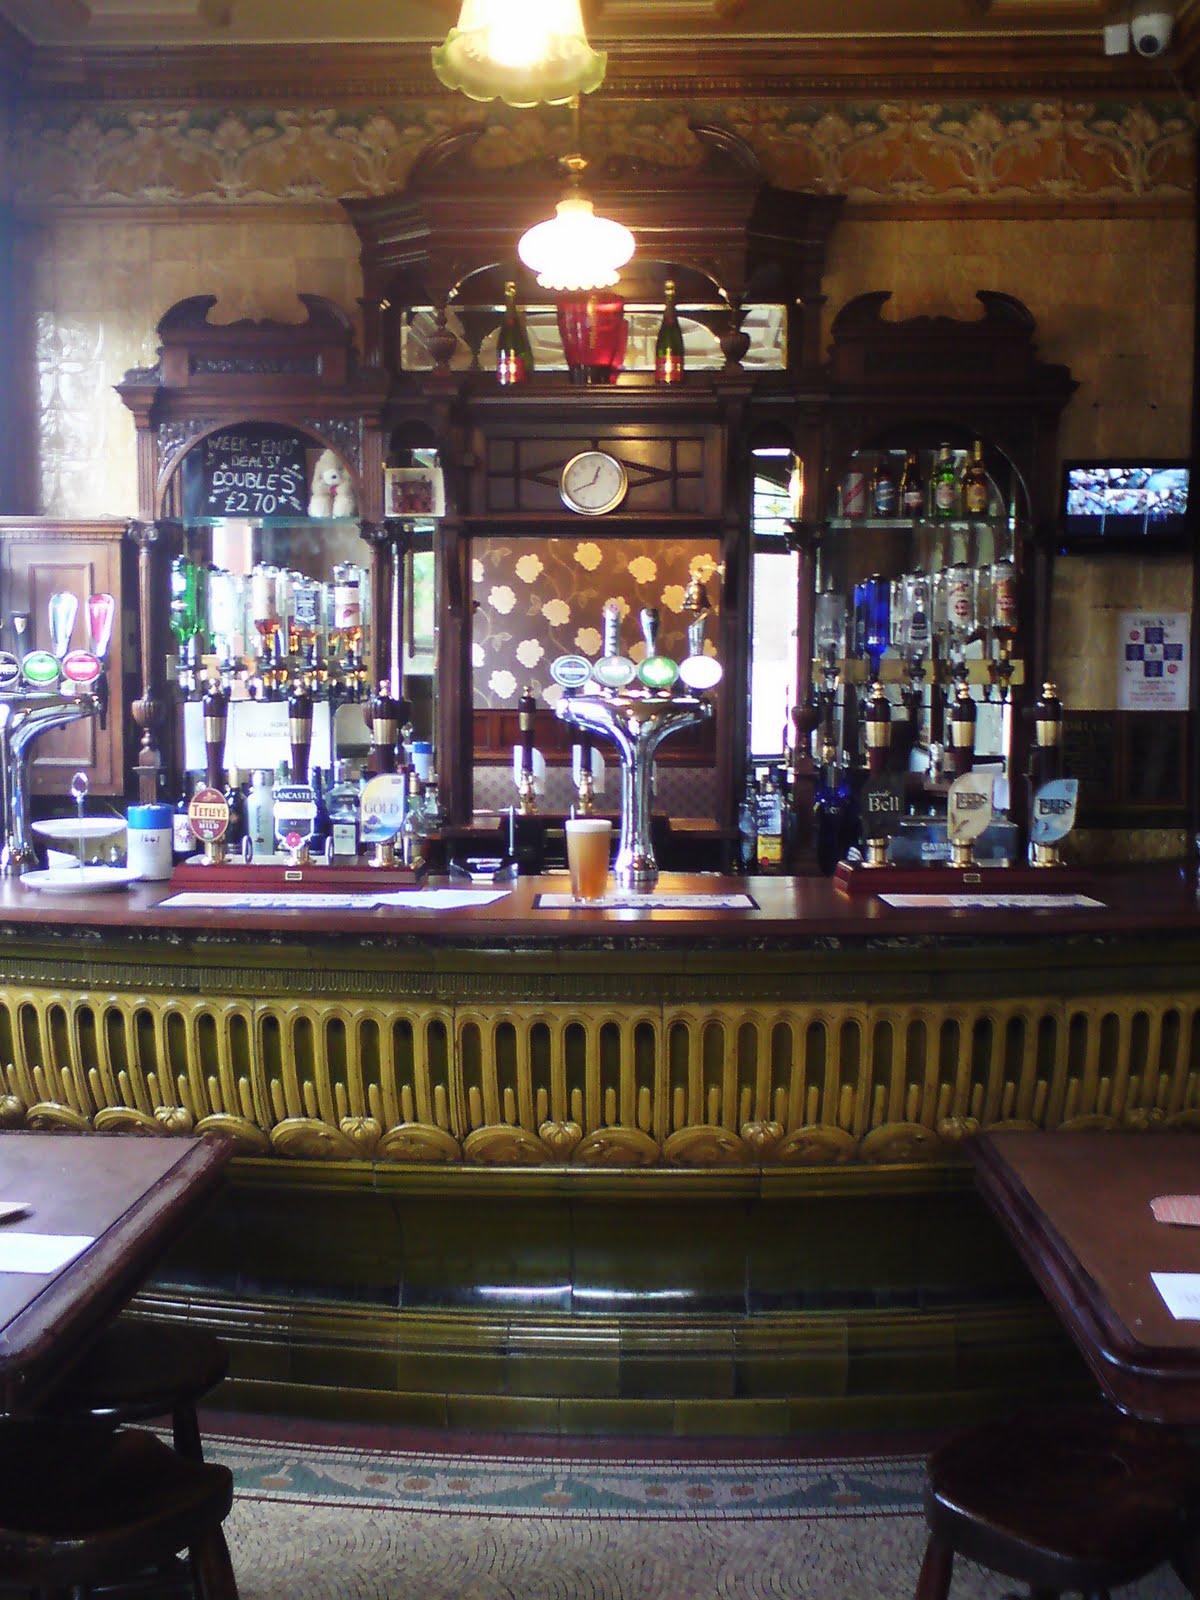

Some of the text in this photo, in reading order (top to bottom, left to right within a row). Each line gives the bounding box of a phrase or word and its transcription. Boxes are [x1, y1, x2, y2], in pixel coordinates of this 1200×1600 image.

[212, 471, 297, 494] DOUBLES
[364, 802, 399, 815] GOLD
[869, 796, 899, 812] Bell
